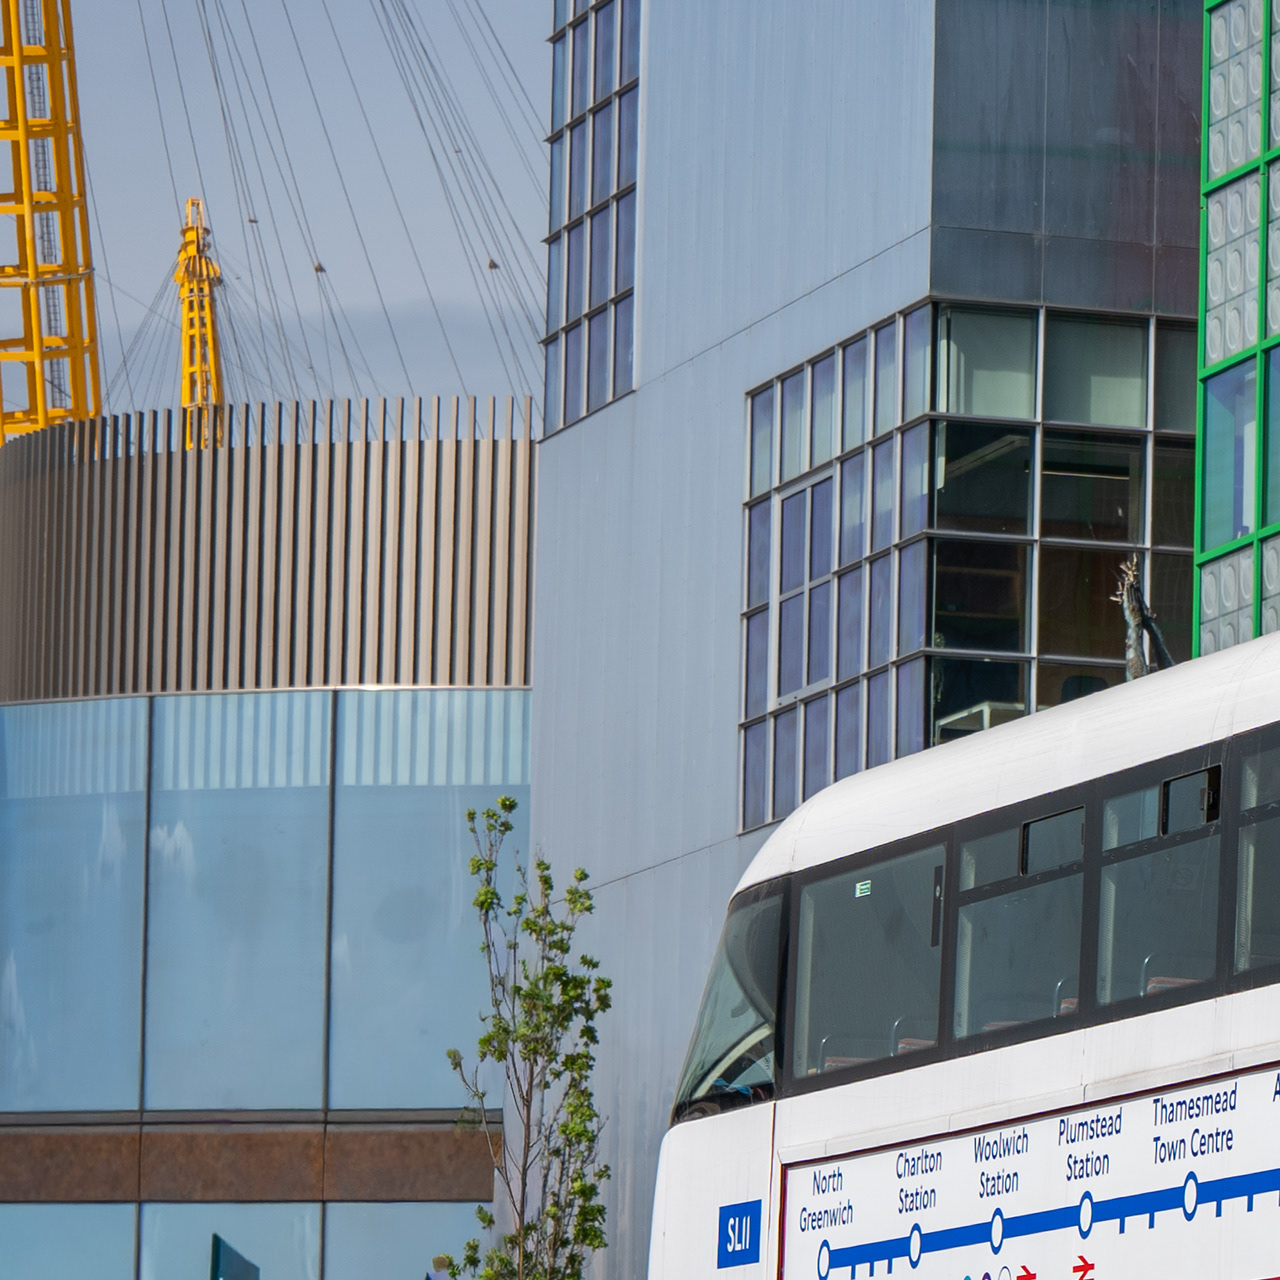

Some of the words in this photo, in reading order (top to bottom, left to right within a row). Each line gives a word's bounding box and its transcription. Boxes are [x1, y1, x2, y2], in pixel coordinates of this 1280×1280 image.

[1153, 1081, 1238, 1126] Thamesmead
[1058, 1106, 1123, 1146] Plumstead
[973, 1127, 1029, 1163] Woolwich
[1153, 1136, 1186, 1164] Town
[1190, 1127, 1234, 1158] Centre
[896, 1149, 942, 1179] Charlton
[1066, 1150, 1110, 1181] Station
[812, 1166, 843, 1196] North
[978, 1168, 1019, 1198] Station
[799, 1199, 853, 1232] Greenwich
[898, 1185, 936, 1214] Station
[727, 1215, 750, 1253] SL11
